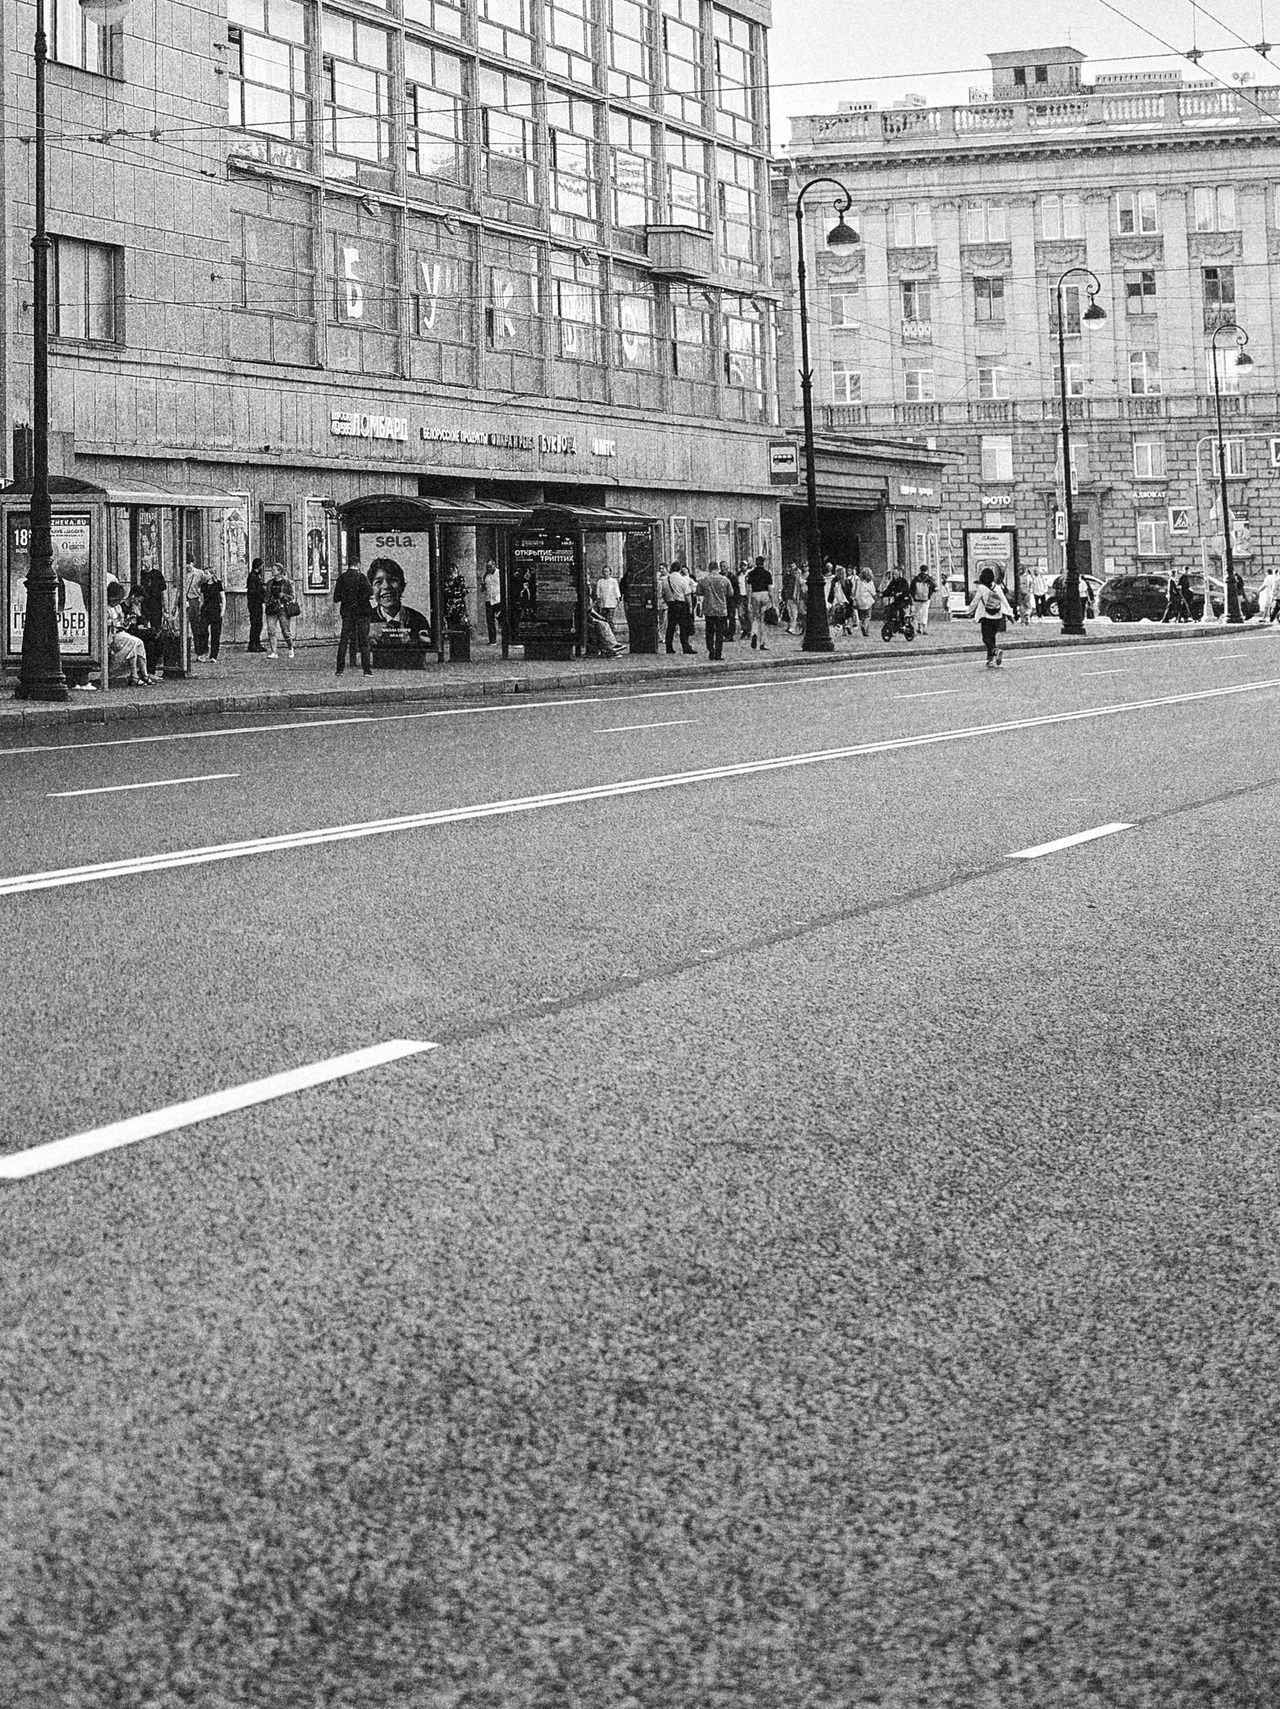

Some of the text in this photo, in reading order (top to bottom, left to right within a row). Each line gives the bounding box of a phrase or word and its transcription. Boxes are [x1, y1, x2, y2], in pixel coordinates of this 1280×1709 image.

[352, 413, 408, 440] ЛОМБАРД
[982, 495, 1011, 505] ФОТО
[14, 612, 86, 629] ГРЬЕВ
